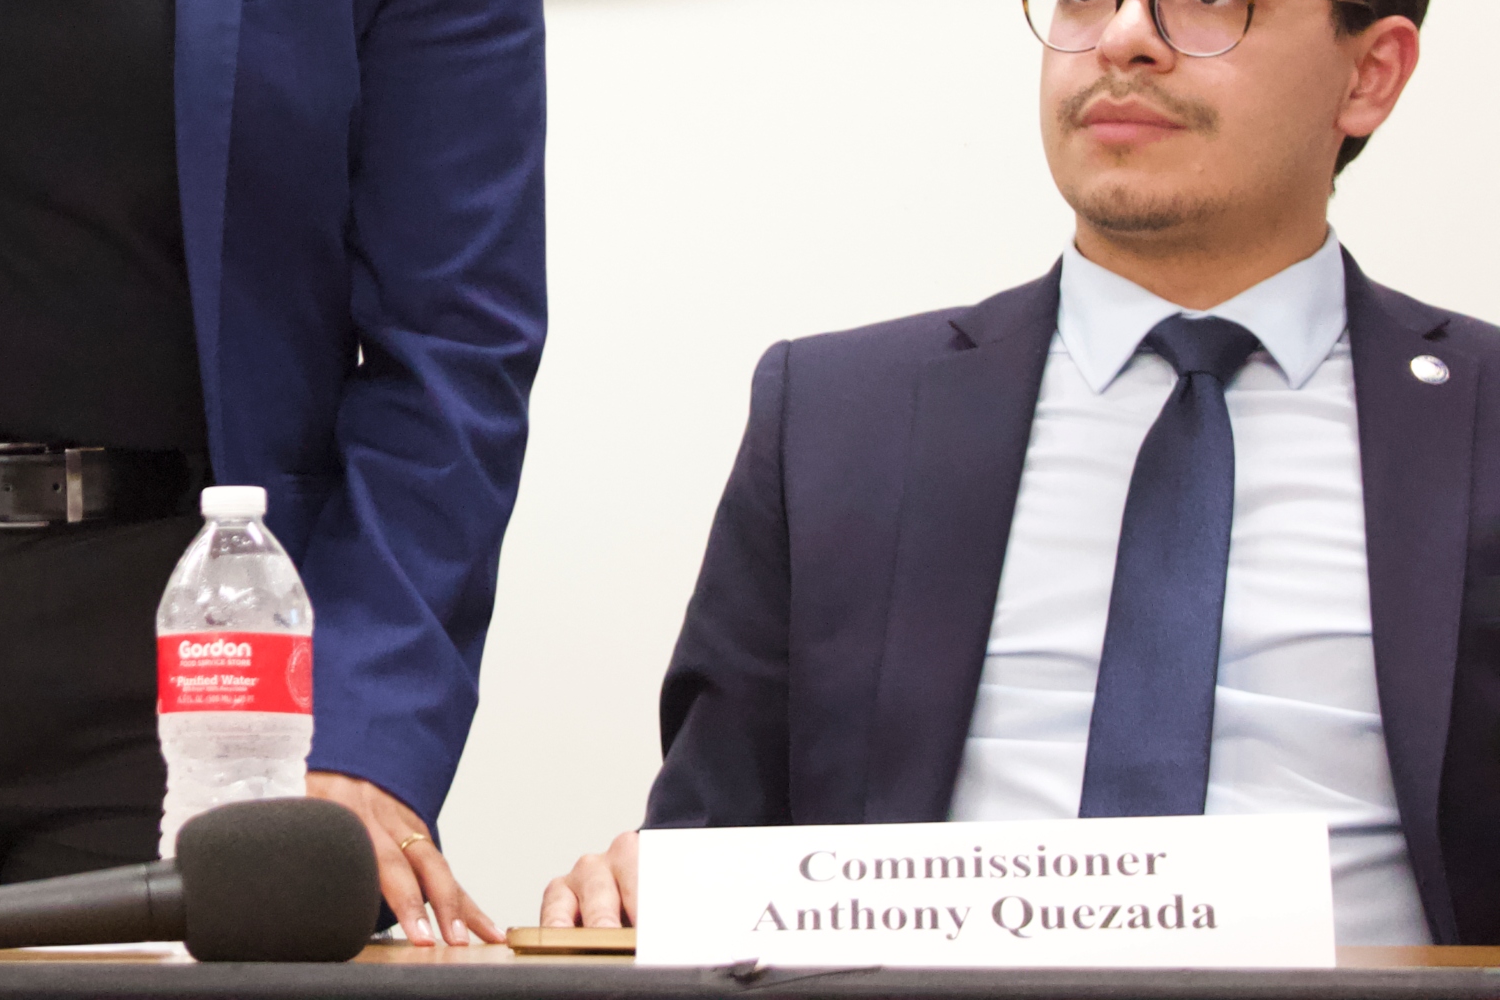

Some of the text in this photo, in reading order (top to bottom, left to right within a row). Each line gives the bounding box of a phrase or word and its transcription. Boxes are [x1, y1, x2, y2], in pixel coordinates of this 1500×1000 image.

[178, 638, 252, 658] Gordon
[177, 675, 256, 687] Purified Water
[798, 845, 1167, 882] Commissioner
[752, 894, 1218, 940] Anthony Quezada
